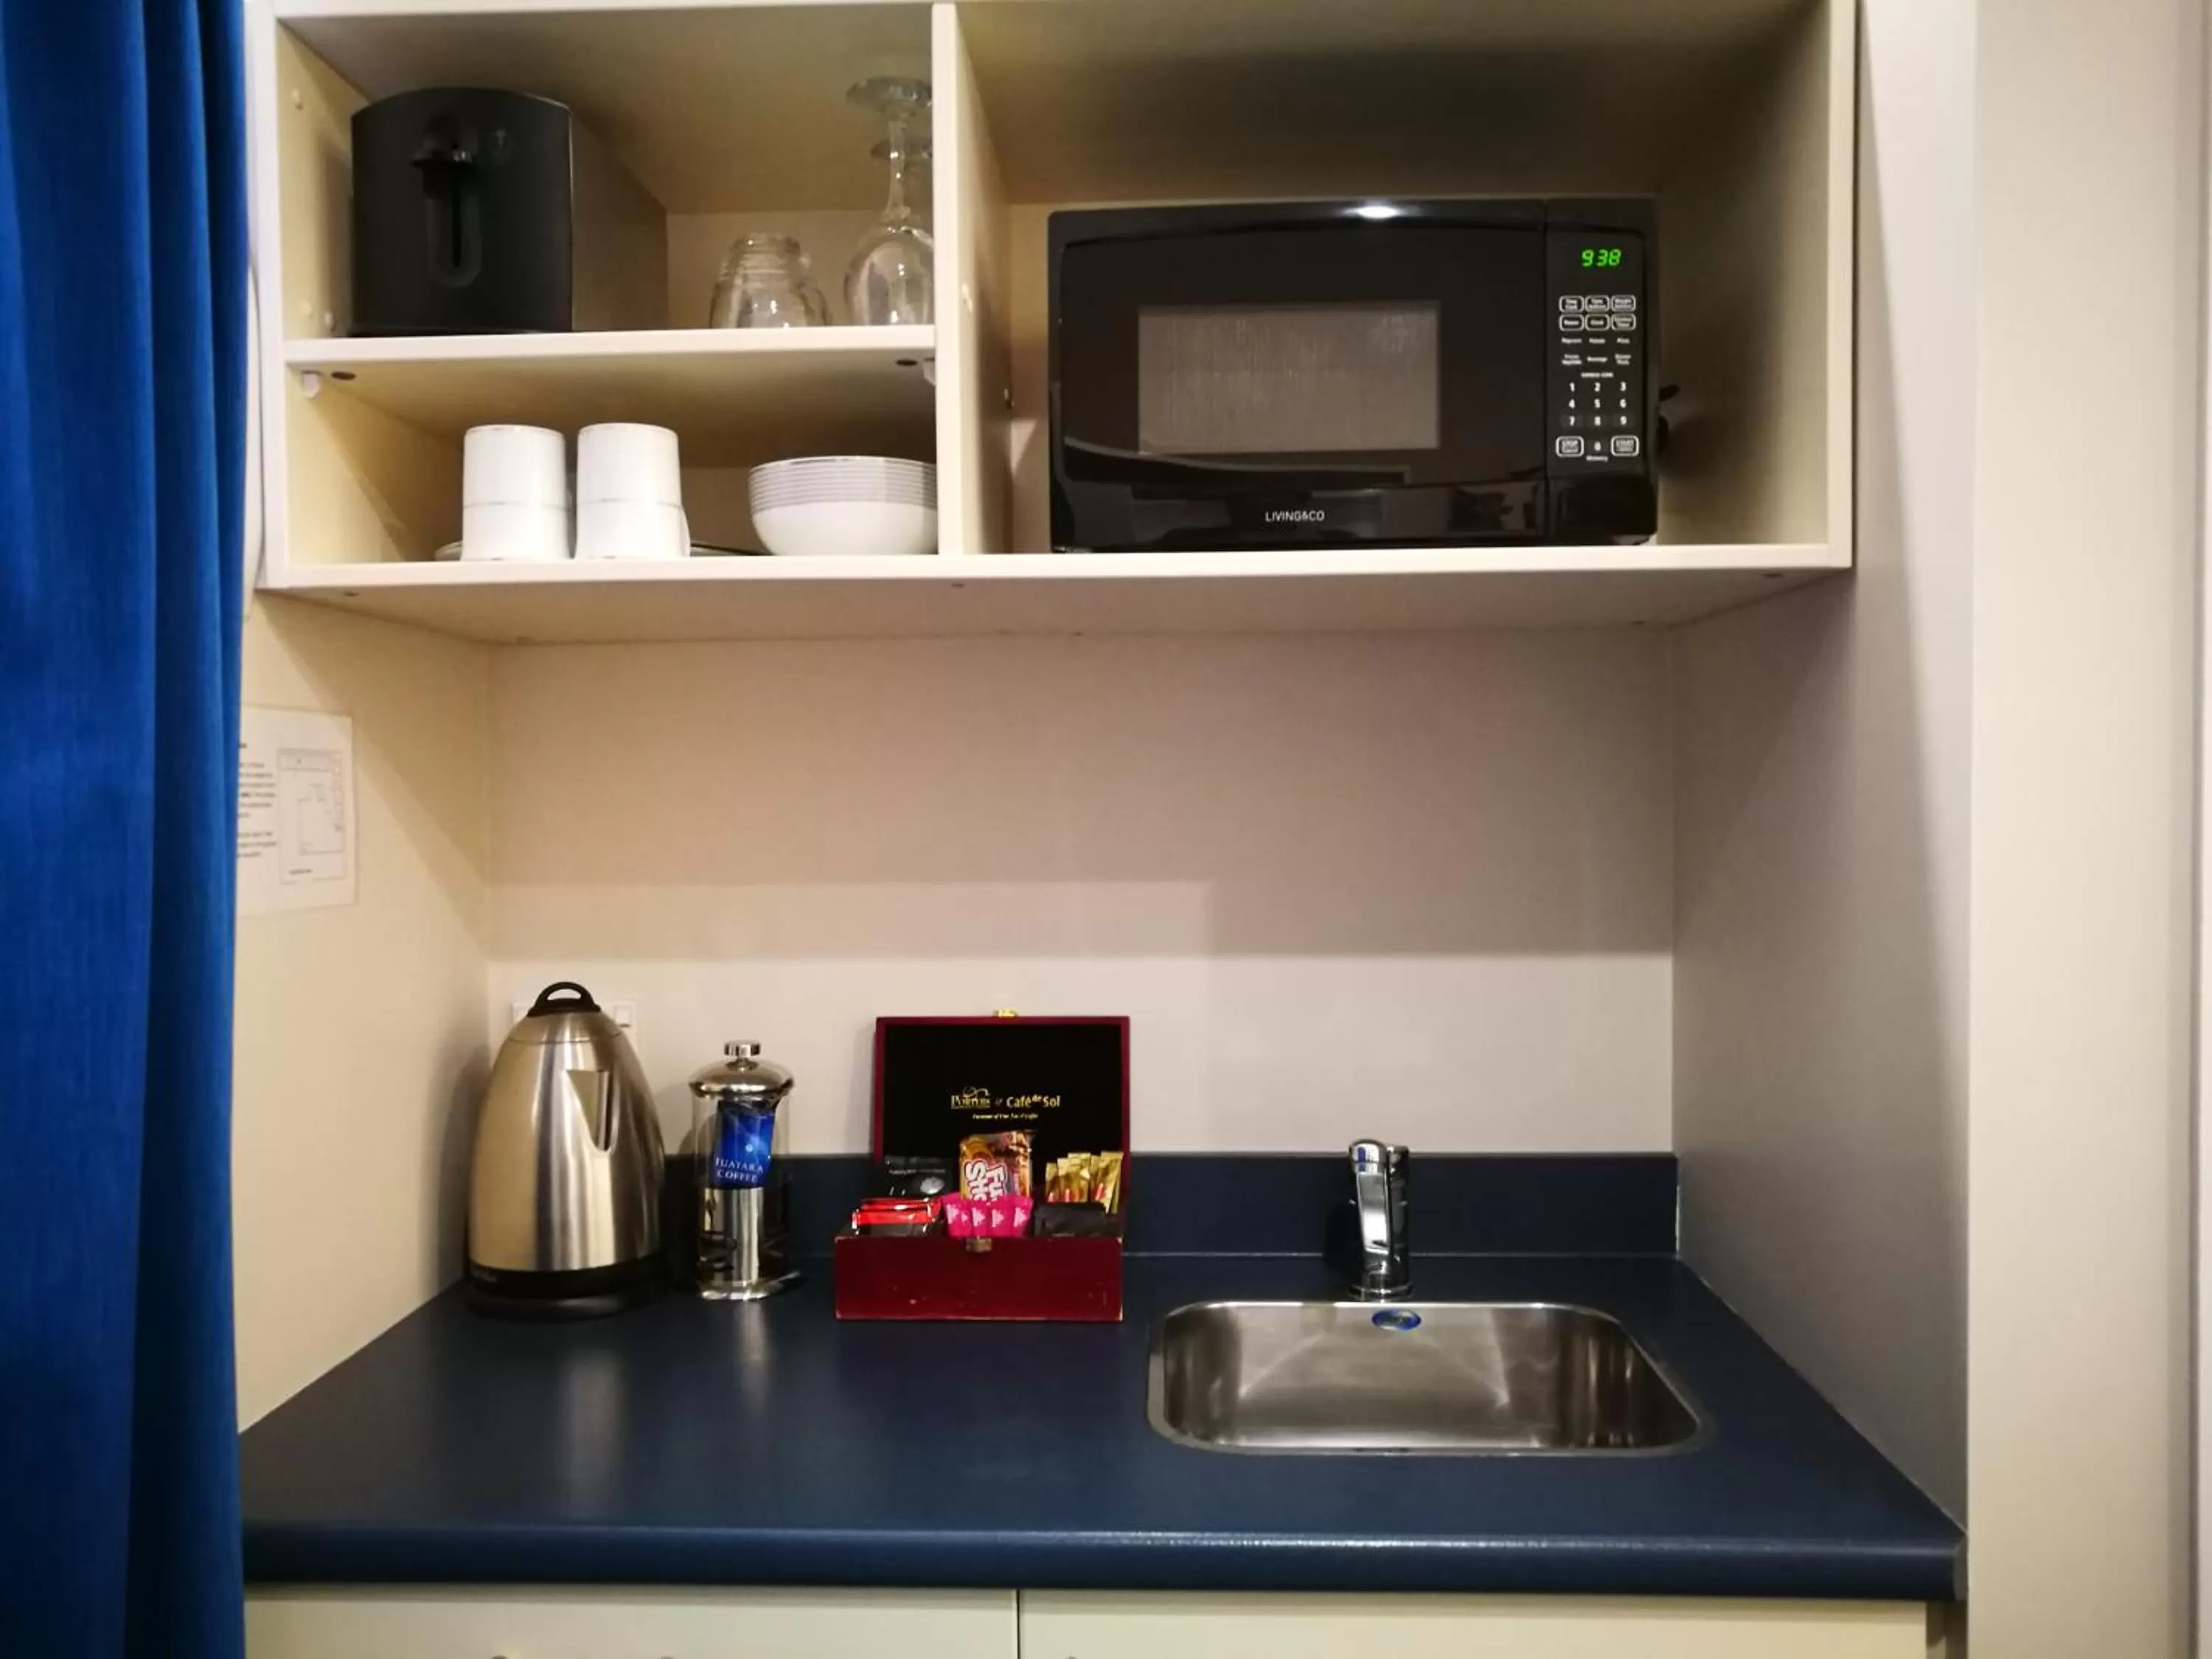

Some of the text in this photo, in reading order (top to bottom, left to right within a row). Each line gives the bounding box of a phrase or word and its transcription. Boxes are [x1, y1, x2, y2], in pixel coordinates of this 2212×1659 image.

[1569, 381, 1627, 392] 1 2 3
[1568, 399, 1627, 408] 4 5 6
[1569, 416, 1627, 425] 7 8 9
[1594, 442, 1601, 451] 0
[1265, 509, 1325, 522] LIVING&CO
[1006, 1095, 1032, 1108] Café
[1043, 1095, 1061, 1107] Sol
[716, 1169, 759, 1183] COFFEE
